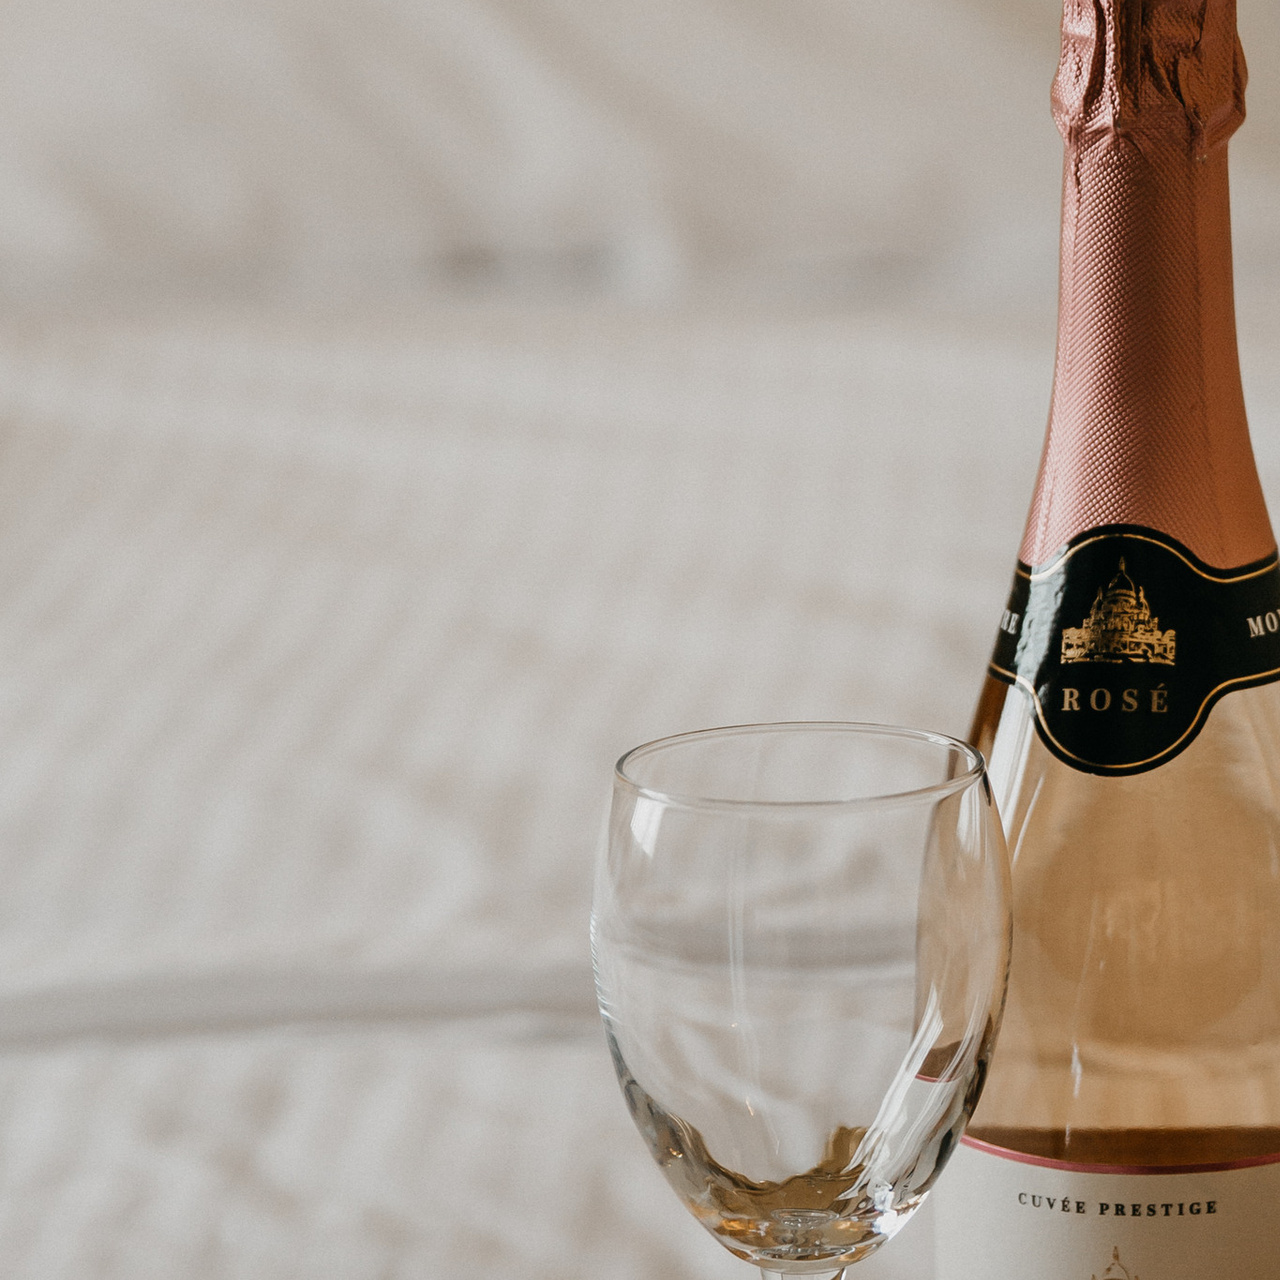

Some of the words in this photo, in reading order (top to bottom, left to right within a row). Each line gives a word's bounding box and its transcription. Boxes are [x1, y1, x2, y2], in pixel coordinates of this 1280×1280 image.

[1061, 682, 1169, 713] ROSÉ
[1018, 1192, 1086, 1214] CUVÉE
[1099, 1200, 1217, 1217] PRESTIGE
